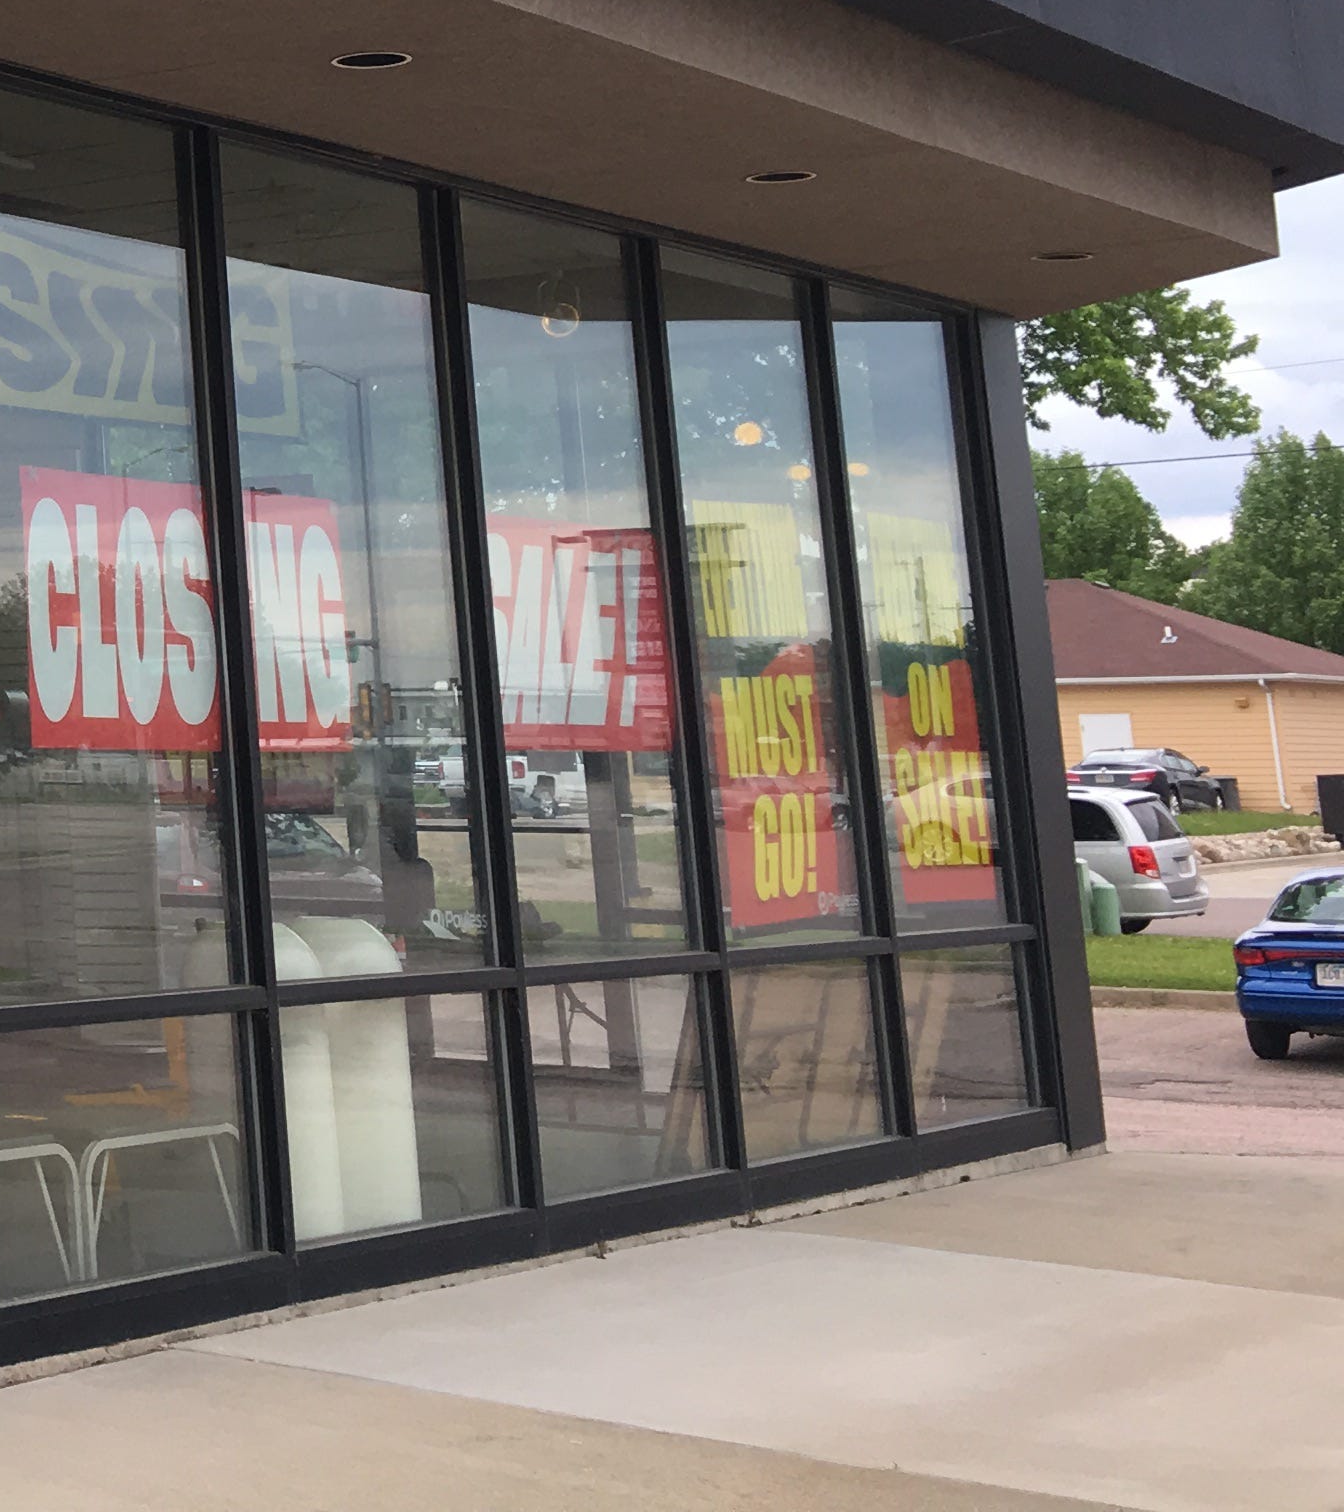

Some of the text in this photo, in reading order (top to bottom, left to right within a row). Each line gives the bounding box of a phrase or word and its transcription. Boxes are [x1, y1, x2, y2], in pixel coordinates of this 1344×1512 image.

[27, 497, 351, 729] CLOSNG
[720, 674, 818, 779] MUST
[907, 662, 956, 738] ON
[753, 792, 817, 902] GO!
[895, 747, 991, 870] SALE!
